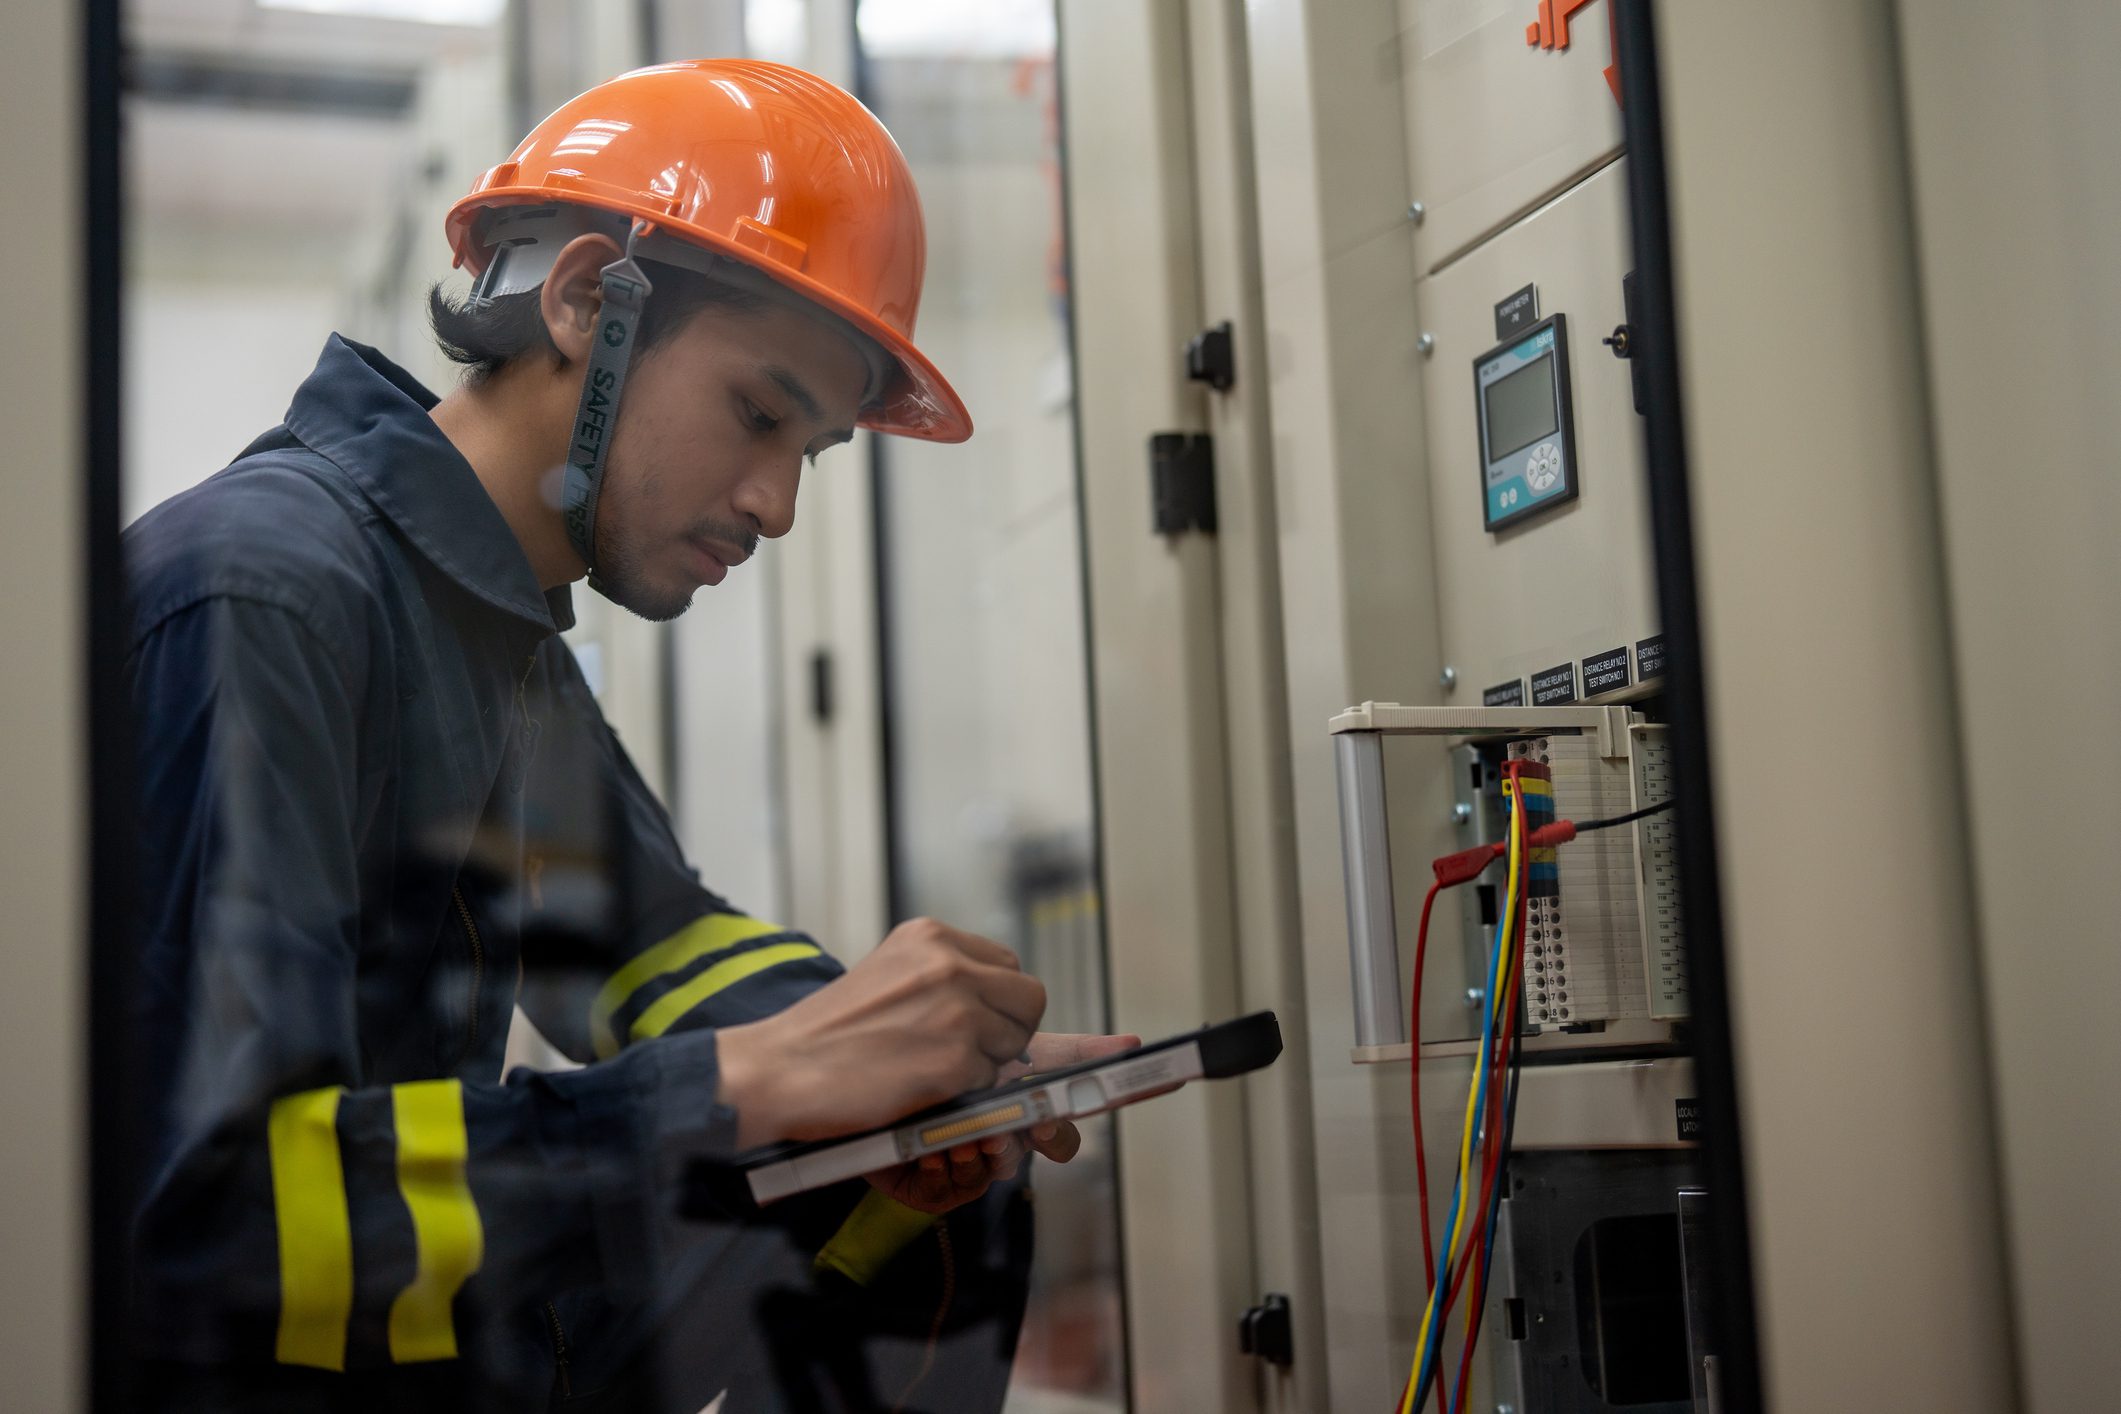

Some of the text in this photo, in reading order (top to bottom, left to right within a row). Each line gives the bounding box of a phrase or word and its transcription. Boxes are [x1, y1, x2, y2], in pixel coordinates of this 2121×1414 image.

[567, 367, 616, 553] SAFETY FIRST
[1638, 644, 1660, 660] DISTANCE
[1584, 662, 1603, 676] DISTANCE
[1603, 658, 1615, 670] RELAY
[1642, 660, 1654, 672] TEST
[1533, 677, 1551, 691] DISTANCE
[1551, 673, 1562, 685] RELAY
[1588, 677, 1598, 688] TEST
[1598, 672, 1614, 685] SWITCH
[1536, 691, 1546, 703] TEST
[1546, 687, 1560, 700] SWITCH
